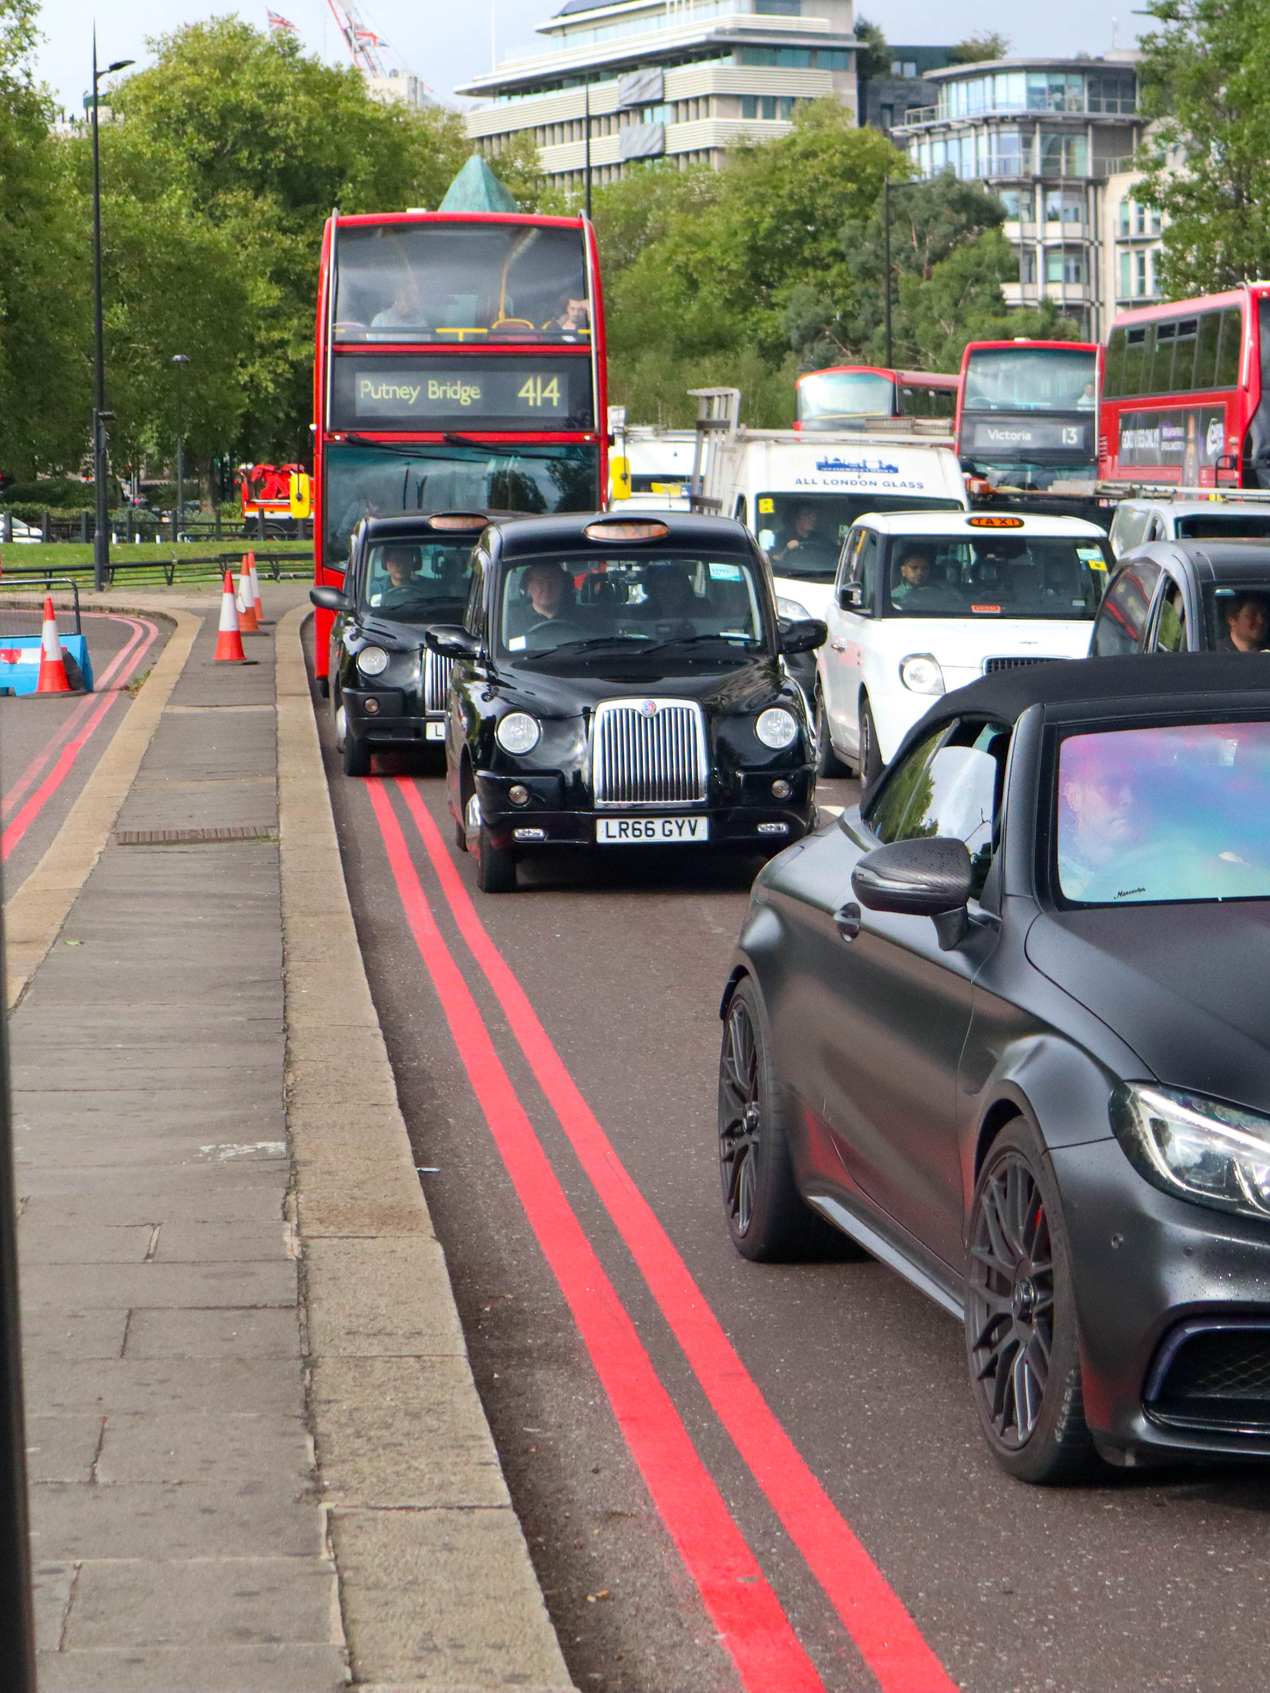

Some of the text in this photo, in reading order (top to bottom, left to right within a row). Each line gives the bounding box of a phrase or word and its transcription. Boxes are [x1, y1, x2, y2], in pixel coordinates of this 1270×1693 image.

[360, 376, 561, 406] Putney Bridge 414
[987, 427, 1078, 444] Victoria 13
[823, 479, 878, 487] LONDON
[883, 481, 924, 490] GLASS
[605, 525, 652, 536] TAXI
[605, 818, 699, 839] LR66 GYV
